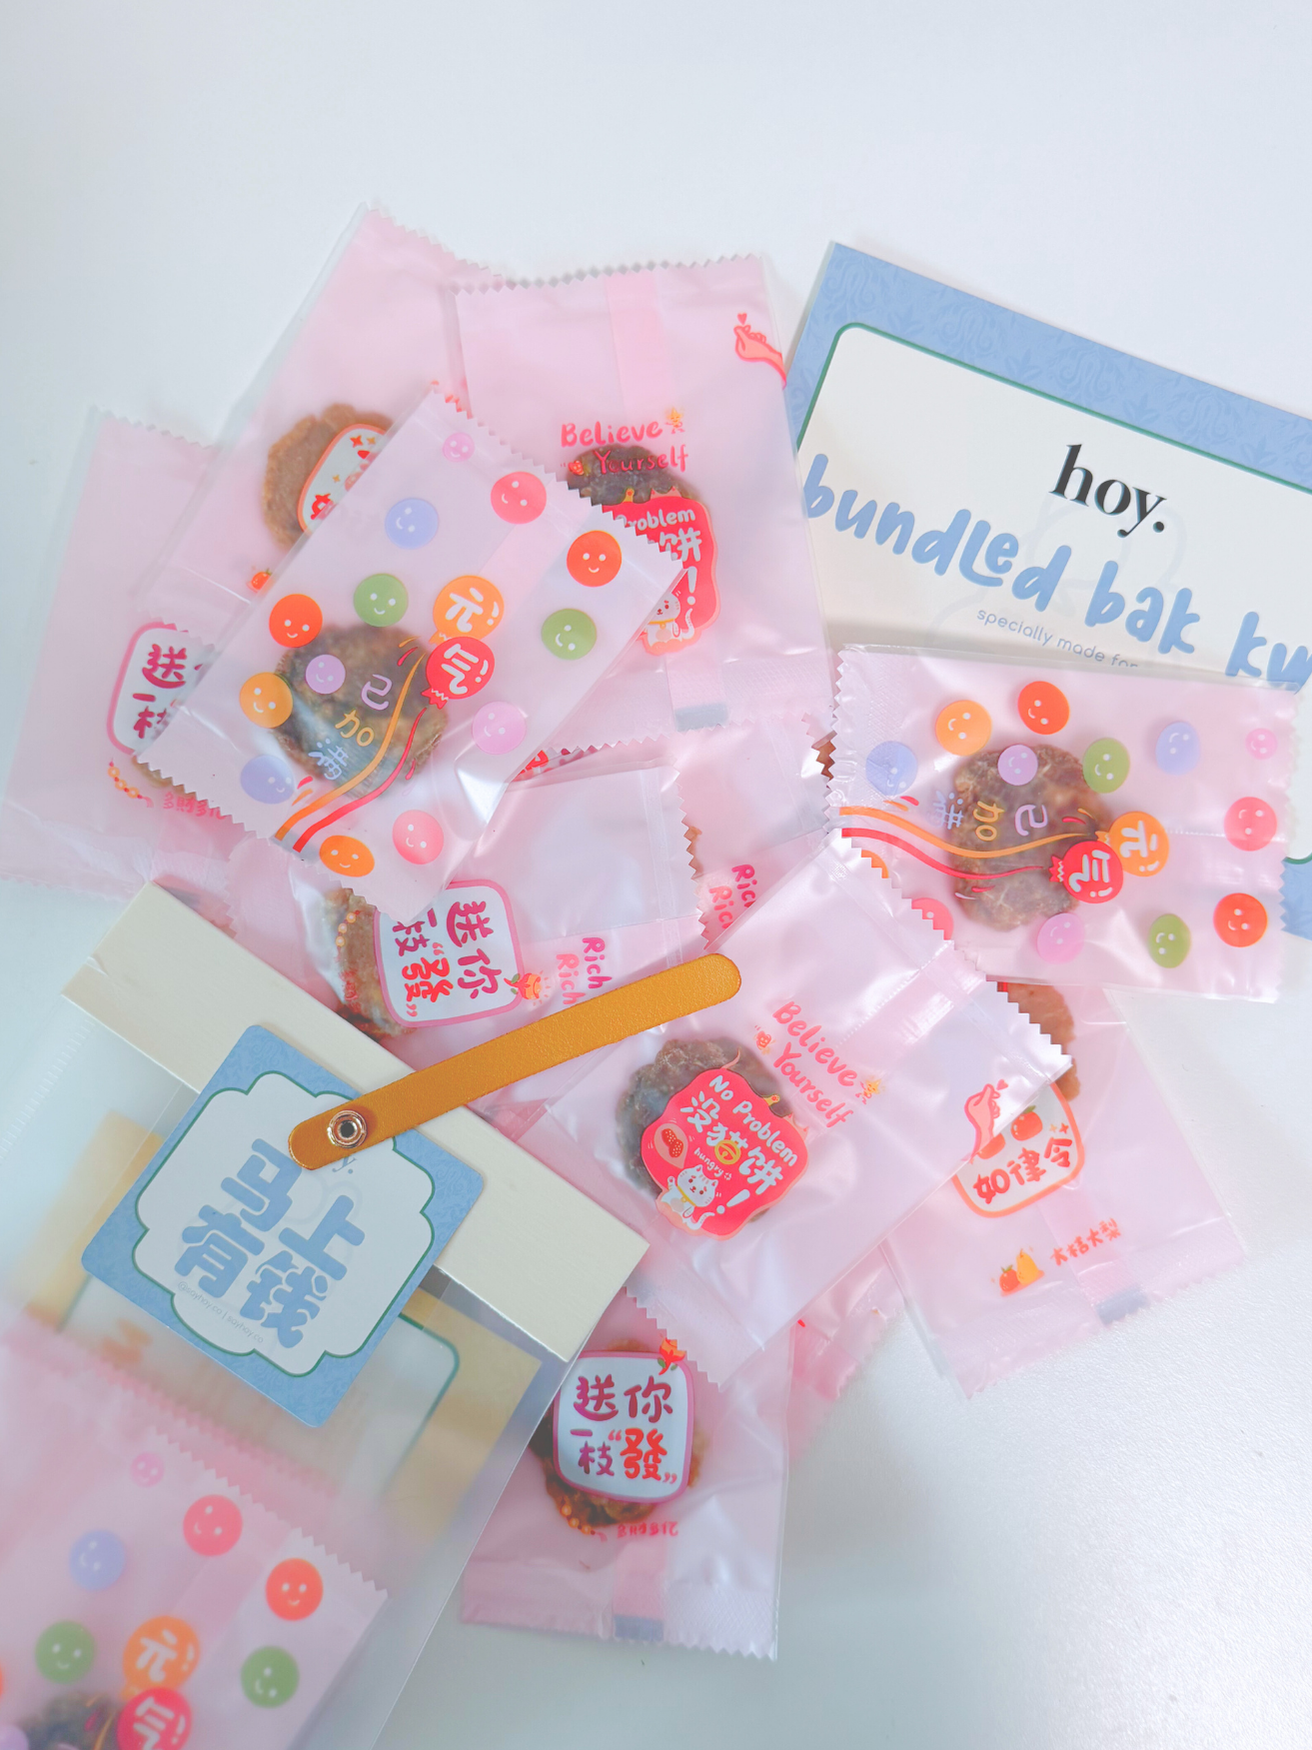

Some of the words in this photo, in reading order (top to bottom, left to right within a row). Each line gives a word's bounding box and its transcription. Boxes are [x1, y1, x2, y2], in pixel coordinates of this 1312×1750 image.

[561, 421, 663, 448] Believe
[593, 444, 688, 475] Yourself
[1049, 443, 1167, 538] hoy.
[803, 453, 1071, 612] bundled
[1084, 561, 1200, 655] bak
[977, 610, 1053, 646] specially
[1057, 638, 1105, 662] made
[446, 901, 502, 999] 送你
[582, 937, 612, 989] Rich
[556, 953, 586, 1005] Rich
[772, 1001, 858, 1087] Believe
[773, 1042, 853, 1128] Yourself
[709, 1075, 733, 1101] No
[733, 1100, 798, 1167] Problem
[693, 1147, 724, 1179] hungry
[573, 1374, 673, 1423] 送你
